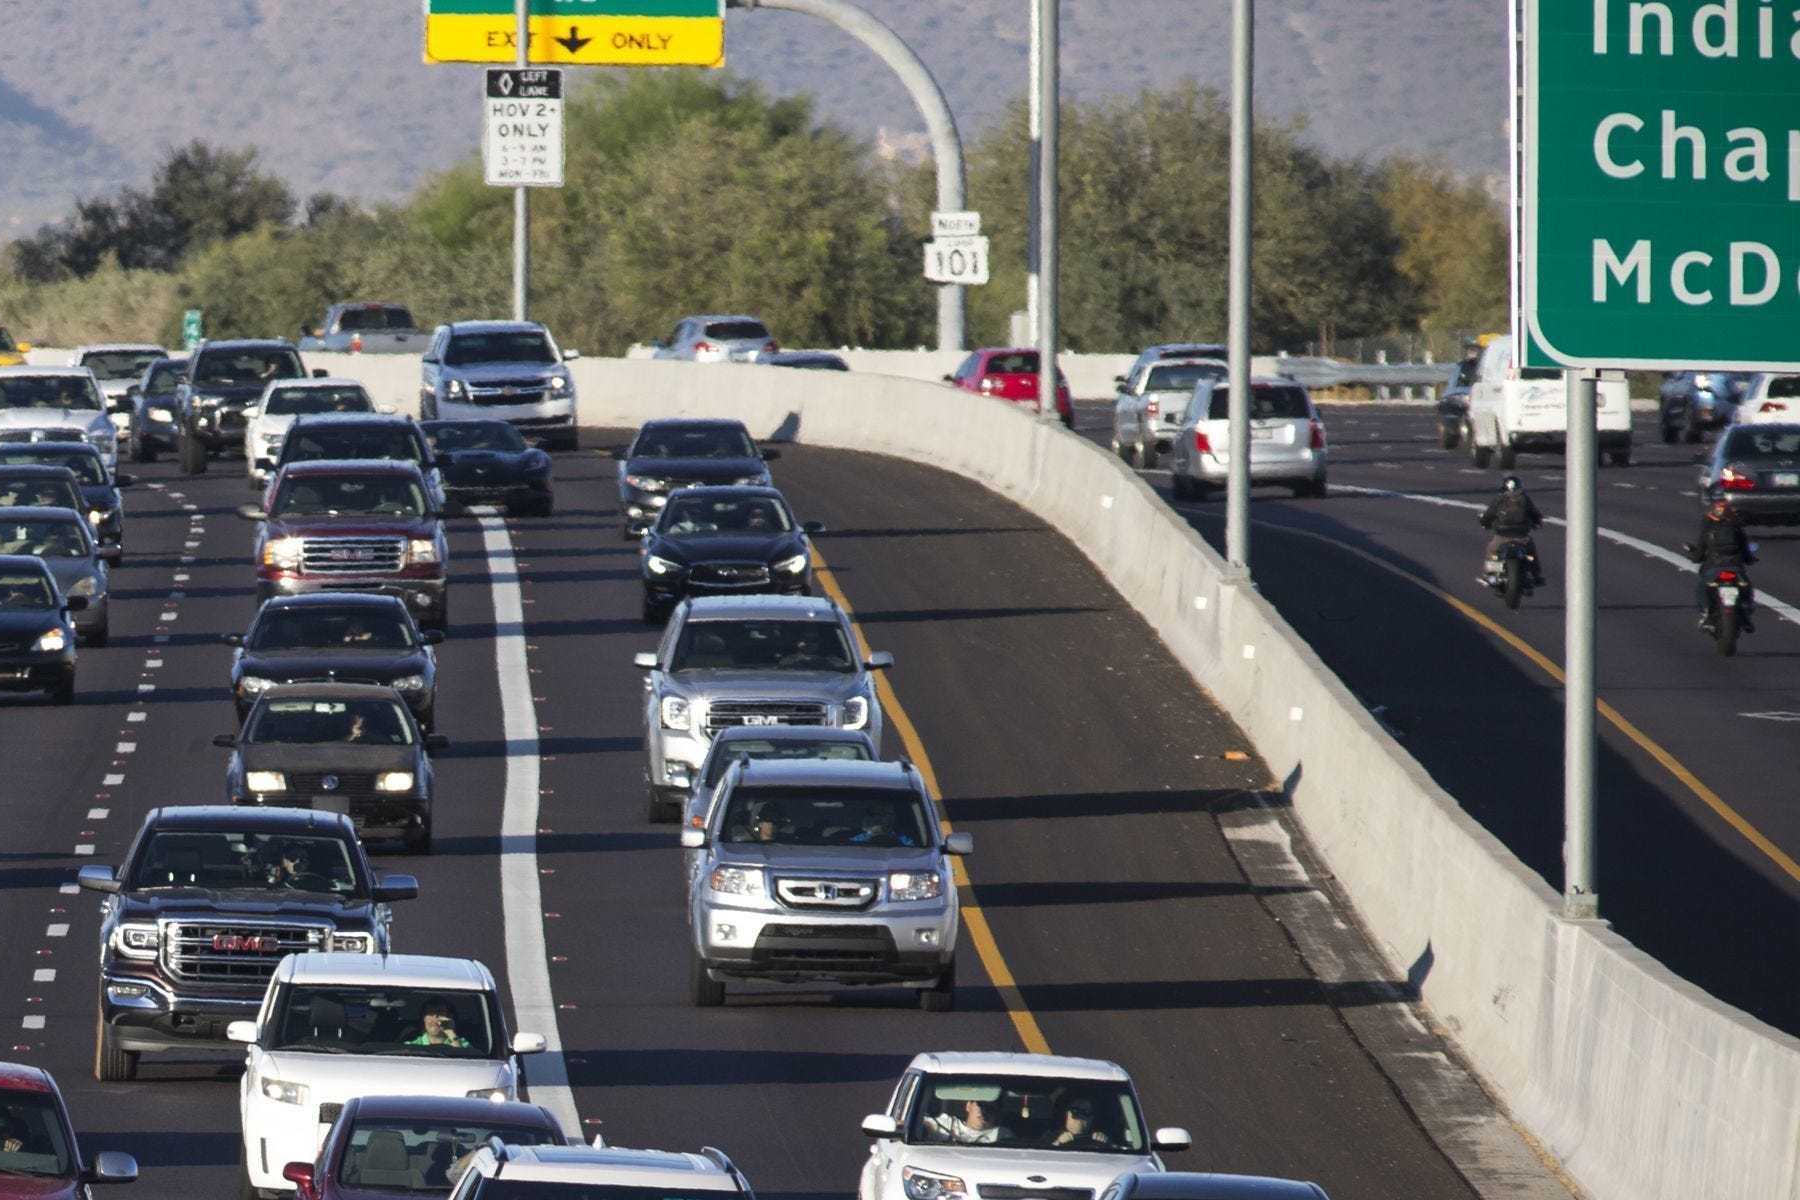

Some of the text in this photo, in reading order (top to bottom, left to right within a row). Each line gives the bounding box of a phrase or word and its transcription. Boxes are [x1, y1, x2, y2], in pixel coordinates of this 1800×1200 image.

[1593, 0, 1800, 58] Indi
[487, 31, 674, 50] EXT ONLY
[520, 71, 548, 81] LEFT
[520, 86, 549, 96] LANE
[493, 103, 530, 117] HOV
[498, 123, 550, 137] ONLY
[1593, 110, 1800, 201] Cha
[936, 249, 978, 276] 101
[1593, 238, 1800, 306] McD
[212, 935, 278, 952] GMC
